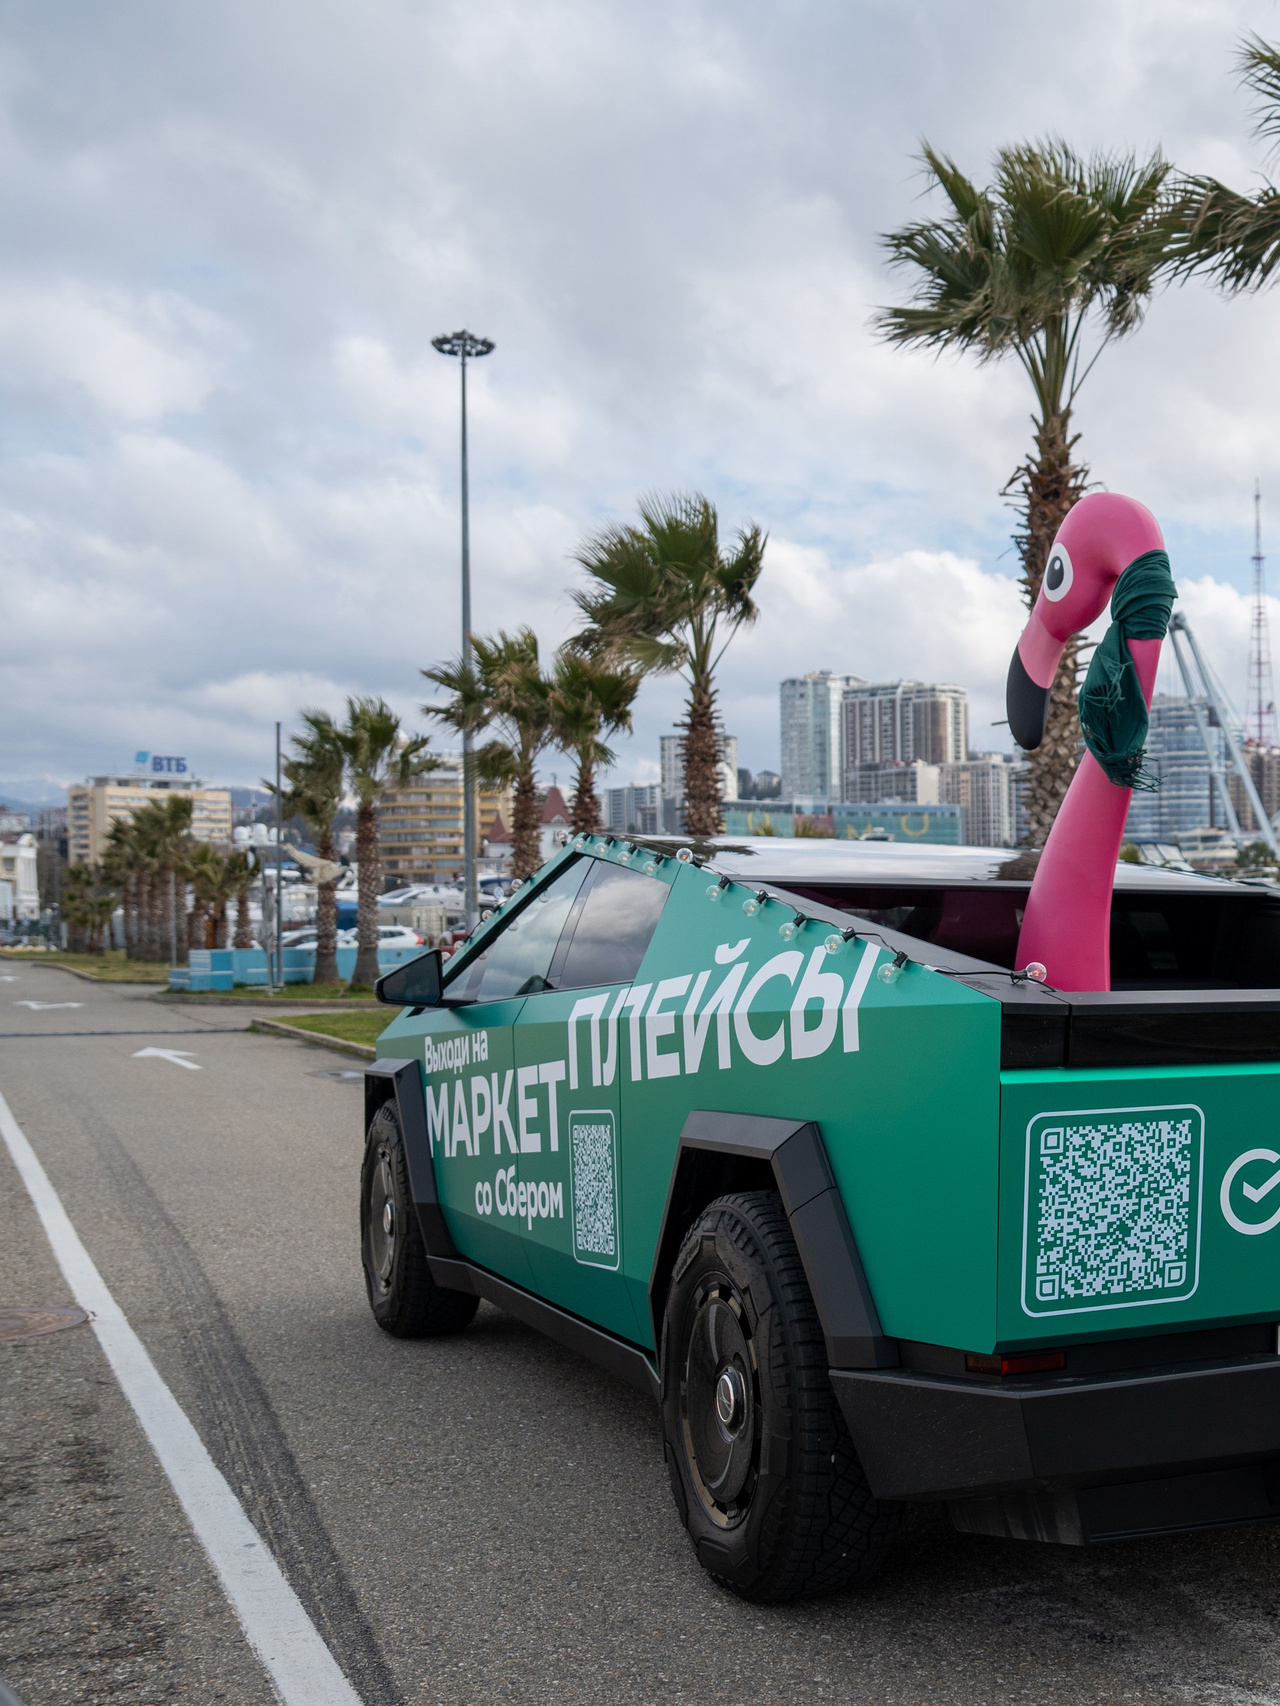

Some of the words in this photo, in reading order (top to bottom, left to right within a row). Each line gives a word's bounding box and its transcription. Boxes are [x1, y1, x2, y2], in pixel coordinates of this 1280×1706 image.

[152, 756, 188, 773] ВТБ
[567, 938, 880, 1090] ПЛЕЙСЫ
[424, 1034, 470, 1075] Выходи
[473, 1030, 489, 1062] на
[426, 1060, 566, 1158] МАРКЕТ
[475, 1181, 492, 1215] со
[495, 1165, 564, 1230] Сбером
